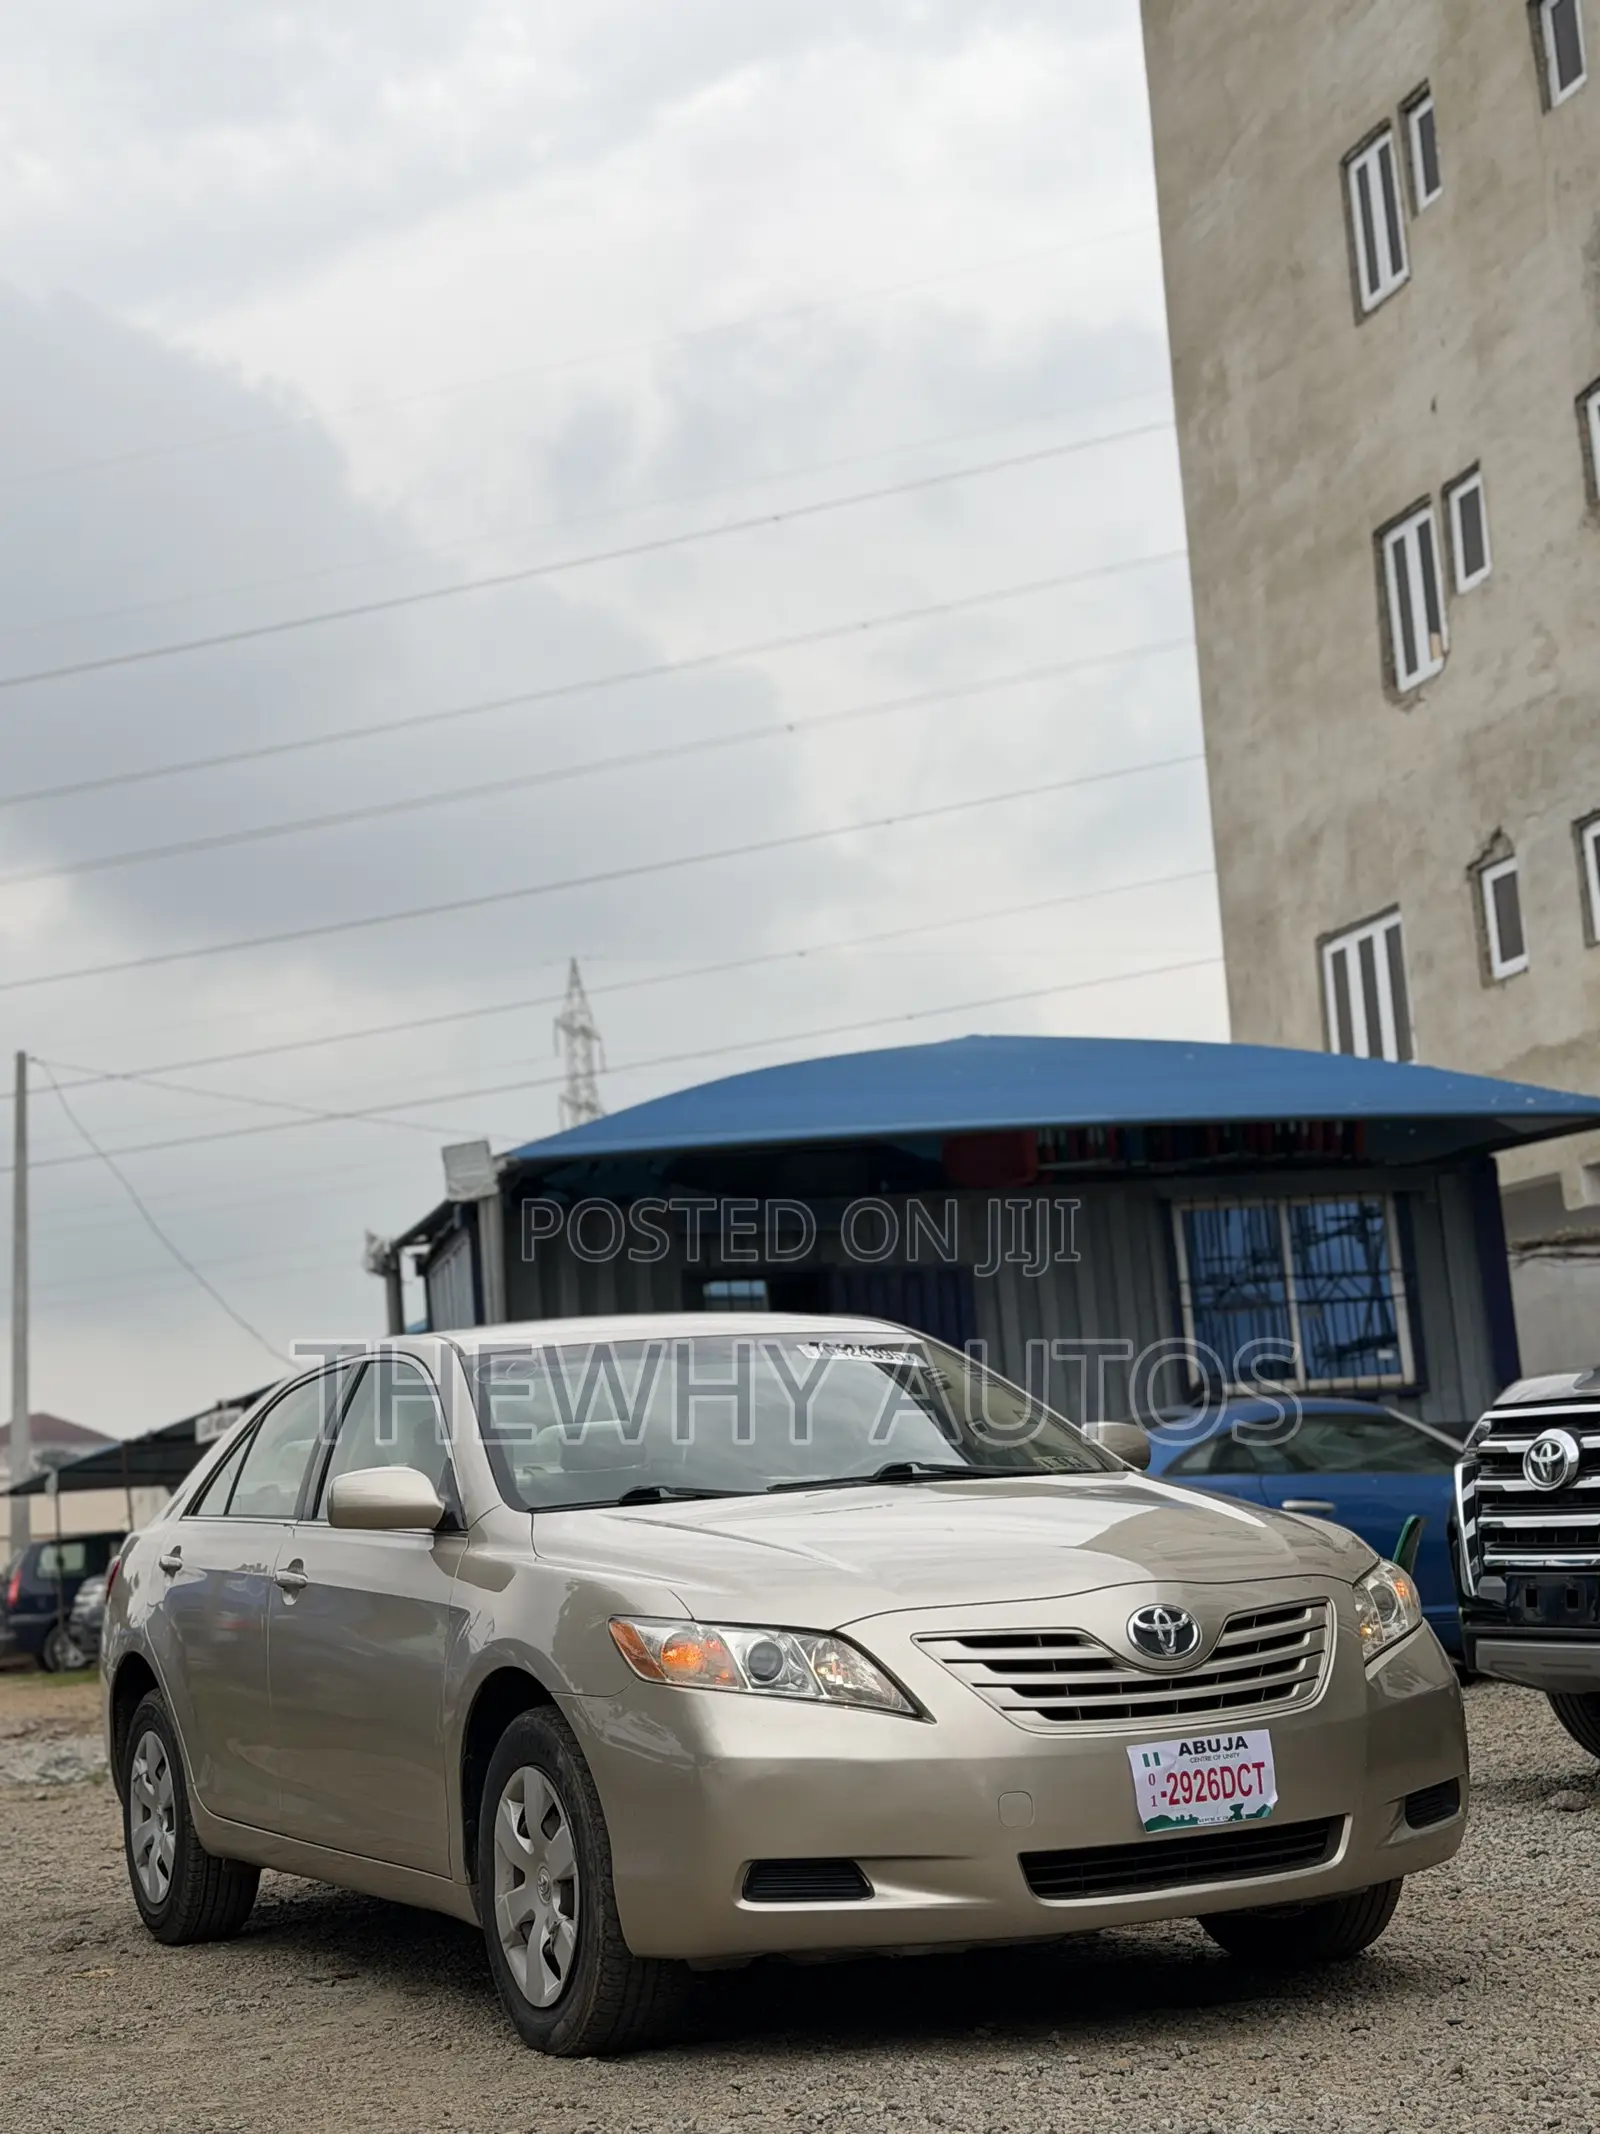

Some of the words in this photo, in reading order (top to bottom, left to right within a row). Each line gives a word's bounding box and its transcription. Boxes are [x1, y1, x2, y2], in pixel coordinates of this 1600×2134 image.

[1178, 1735, 1249, 1757] ABUJA
[1189, 1754, 1212, 1764] CENTRE
[1213, 1753, 1221, 1761] OF
[1222, 1751, 1240, 1760] UNITY
